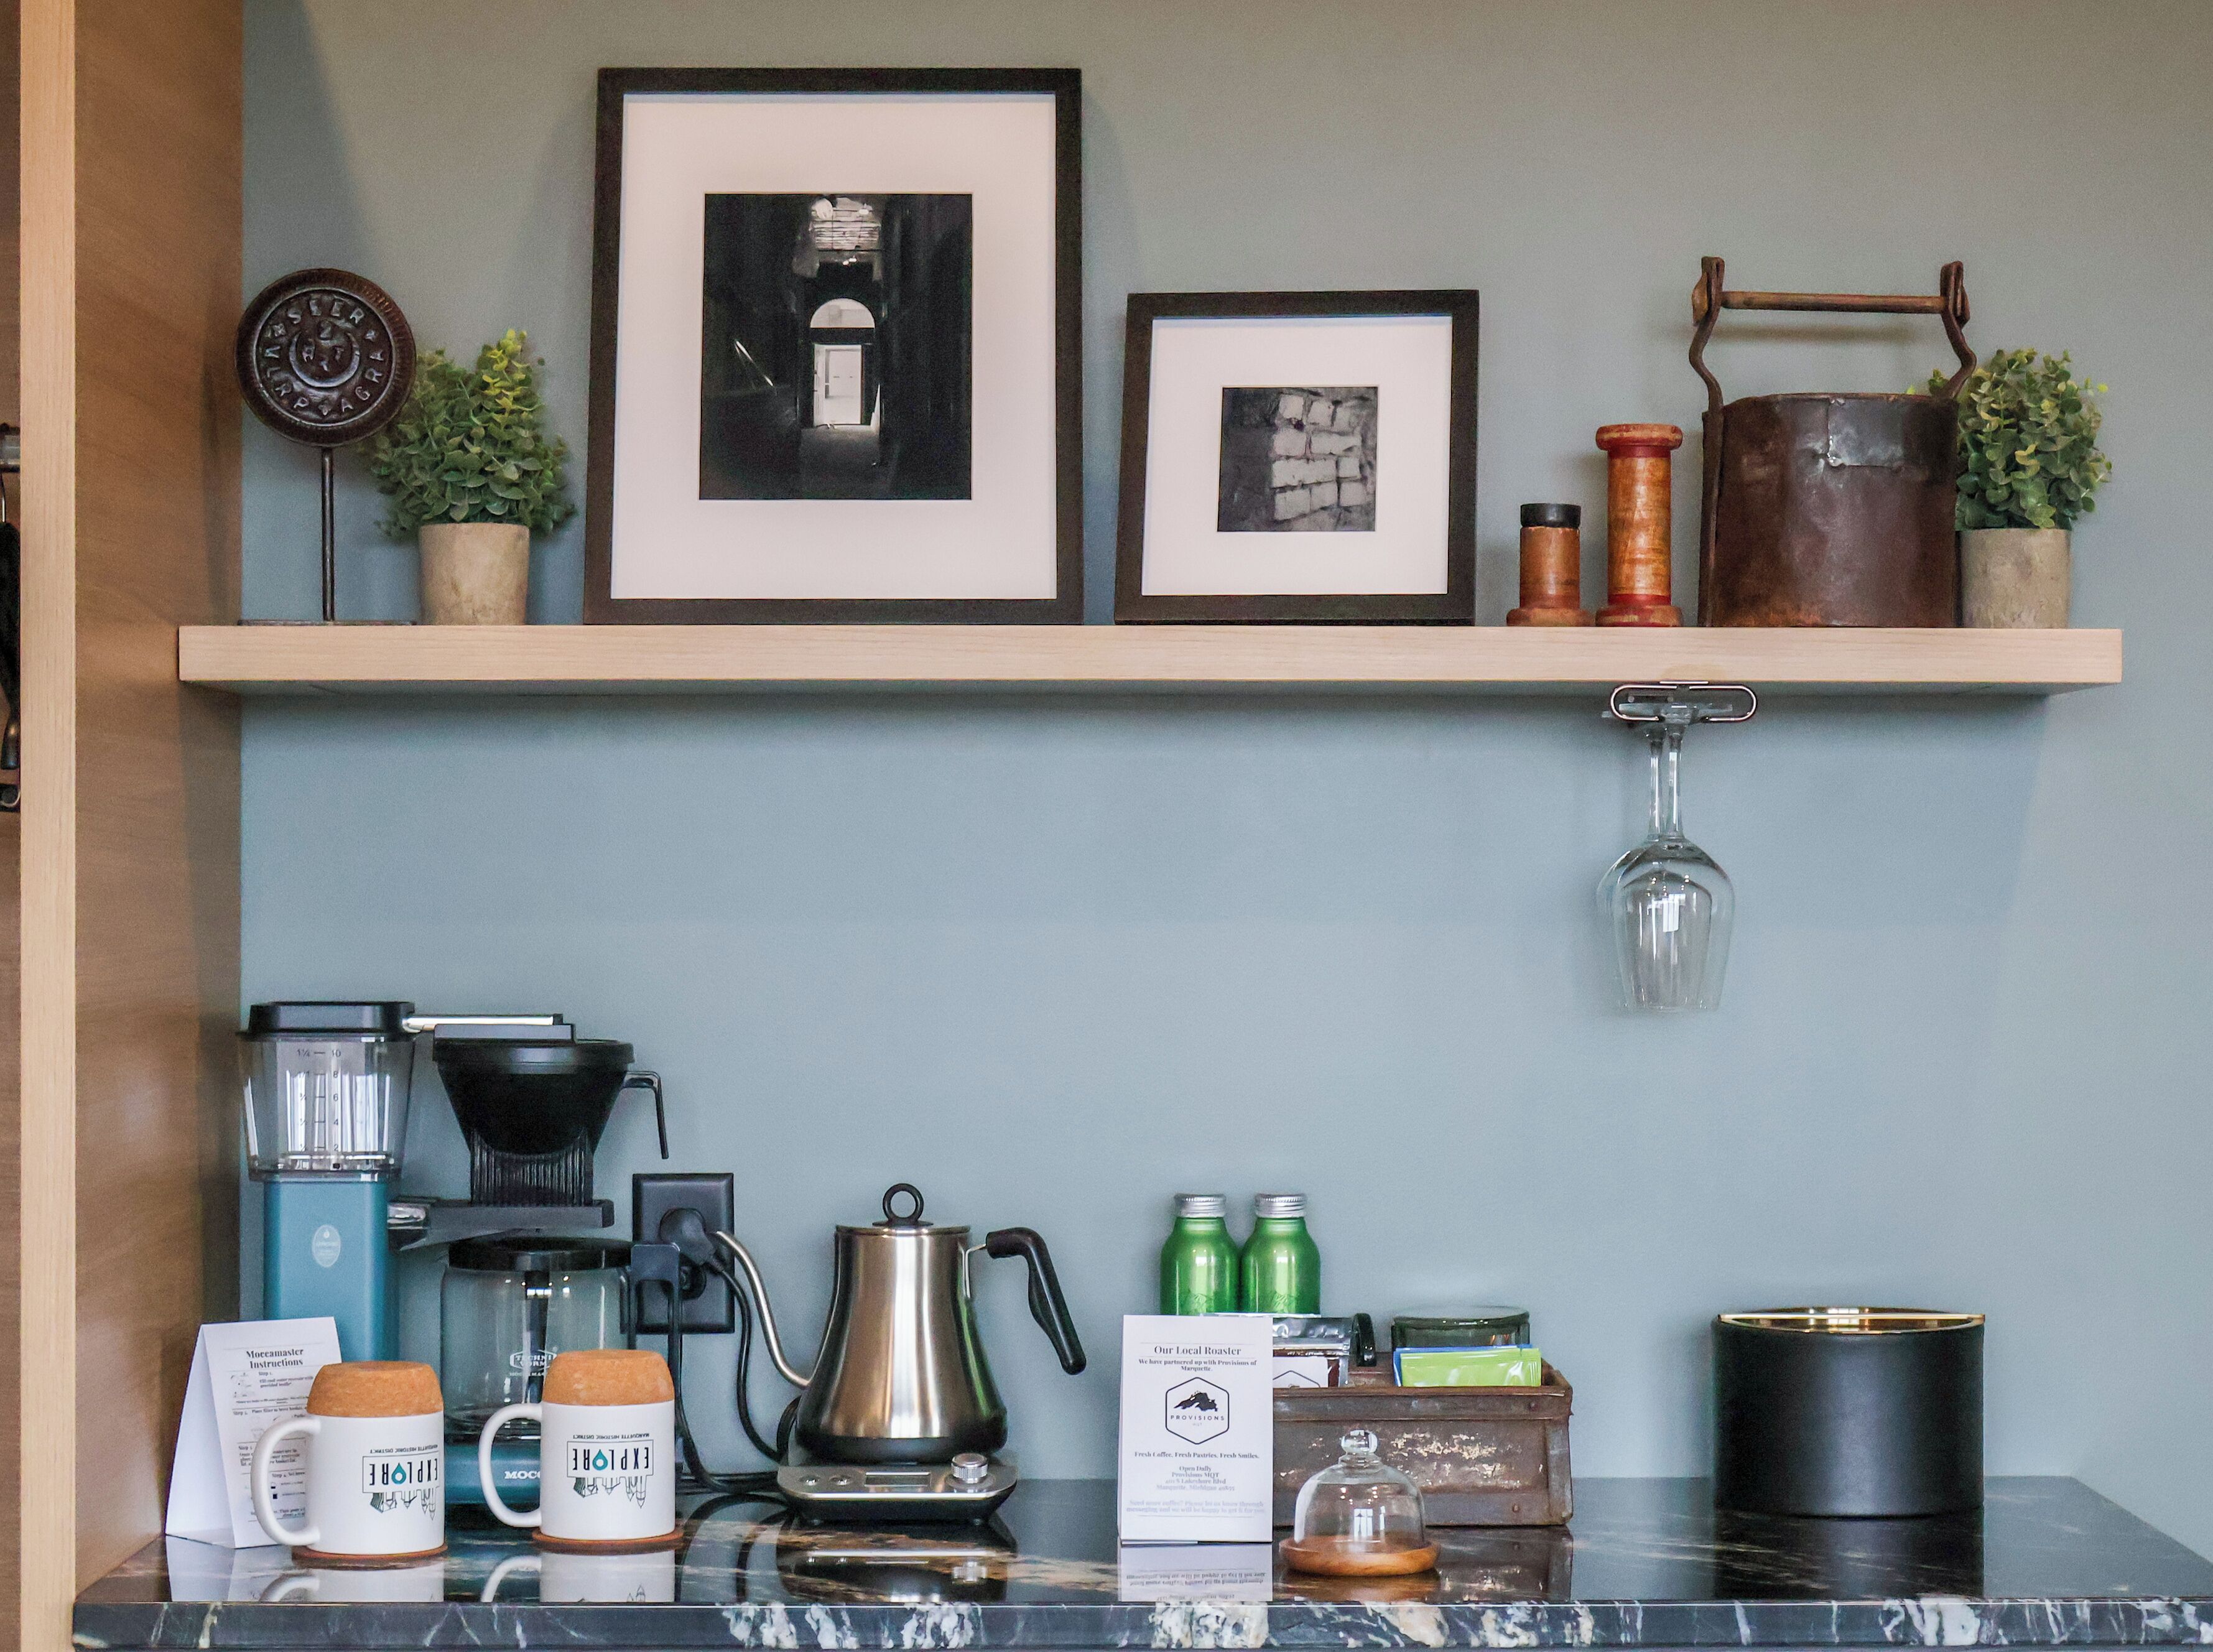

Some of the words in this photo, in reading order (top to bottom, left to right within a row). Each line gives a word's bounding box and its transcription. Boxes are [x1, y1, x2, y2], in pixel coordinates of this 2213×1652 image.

[333, 1093, 338, 1102] 6
[246, 1348, 304, 1358] Moccamaster
[1154, 1345, 1173, 1354] Our
[1176, 1346, 1202, 1355] Local
[1205, 1347, 1241, 1355] Roaster
[249, 1358, 303, 1369] Instructions
[572, 1447, 649, 1471] EXPLORE
[369, 1458, 438, 1486] EXPLORE
